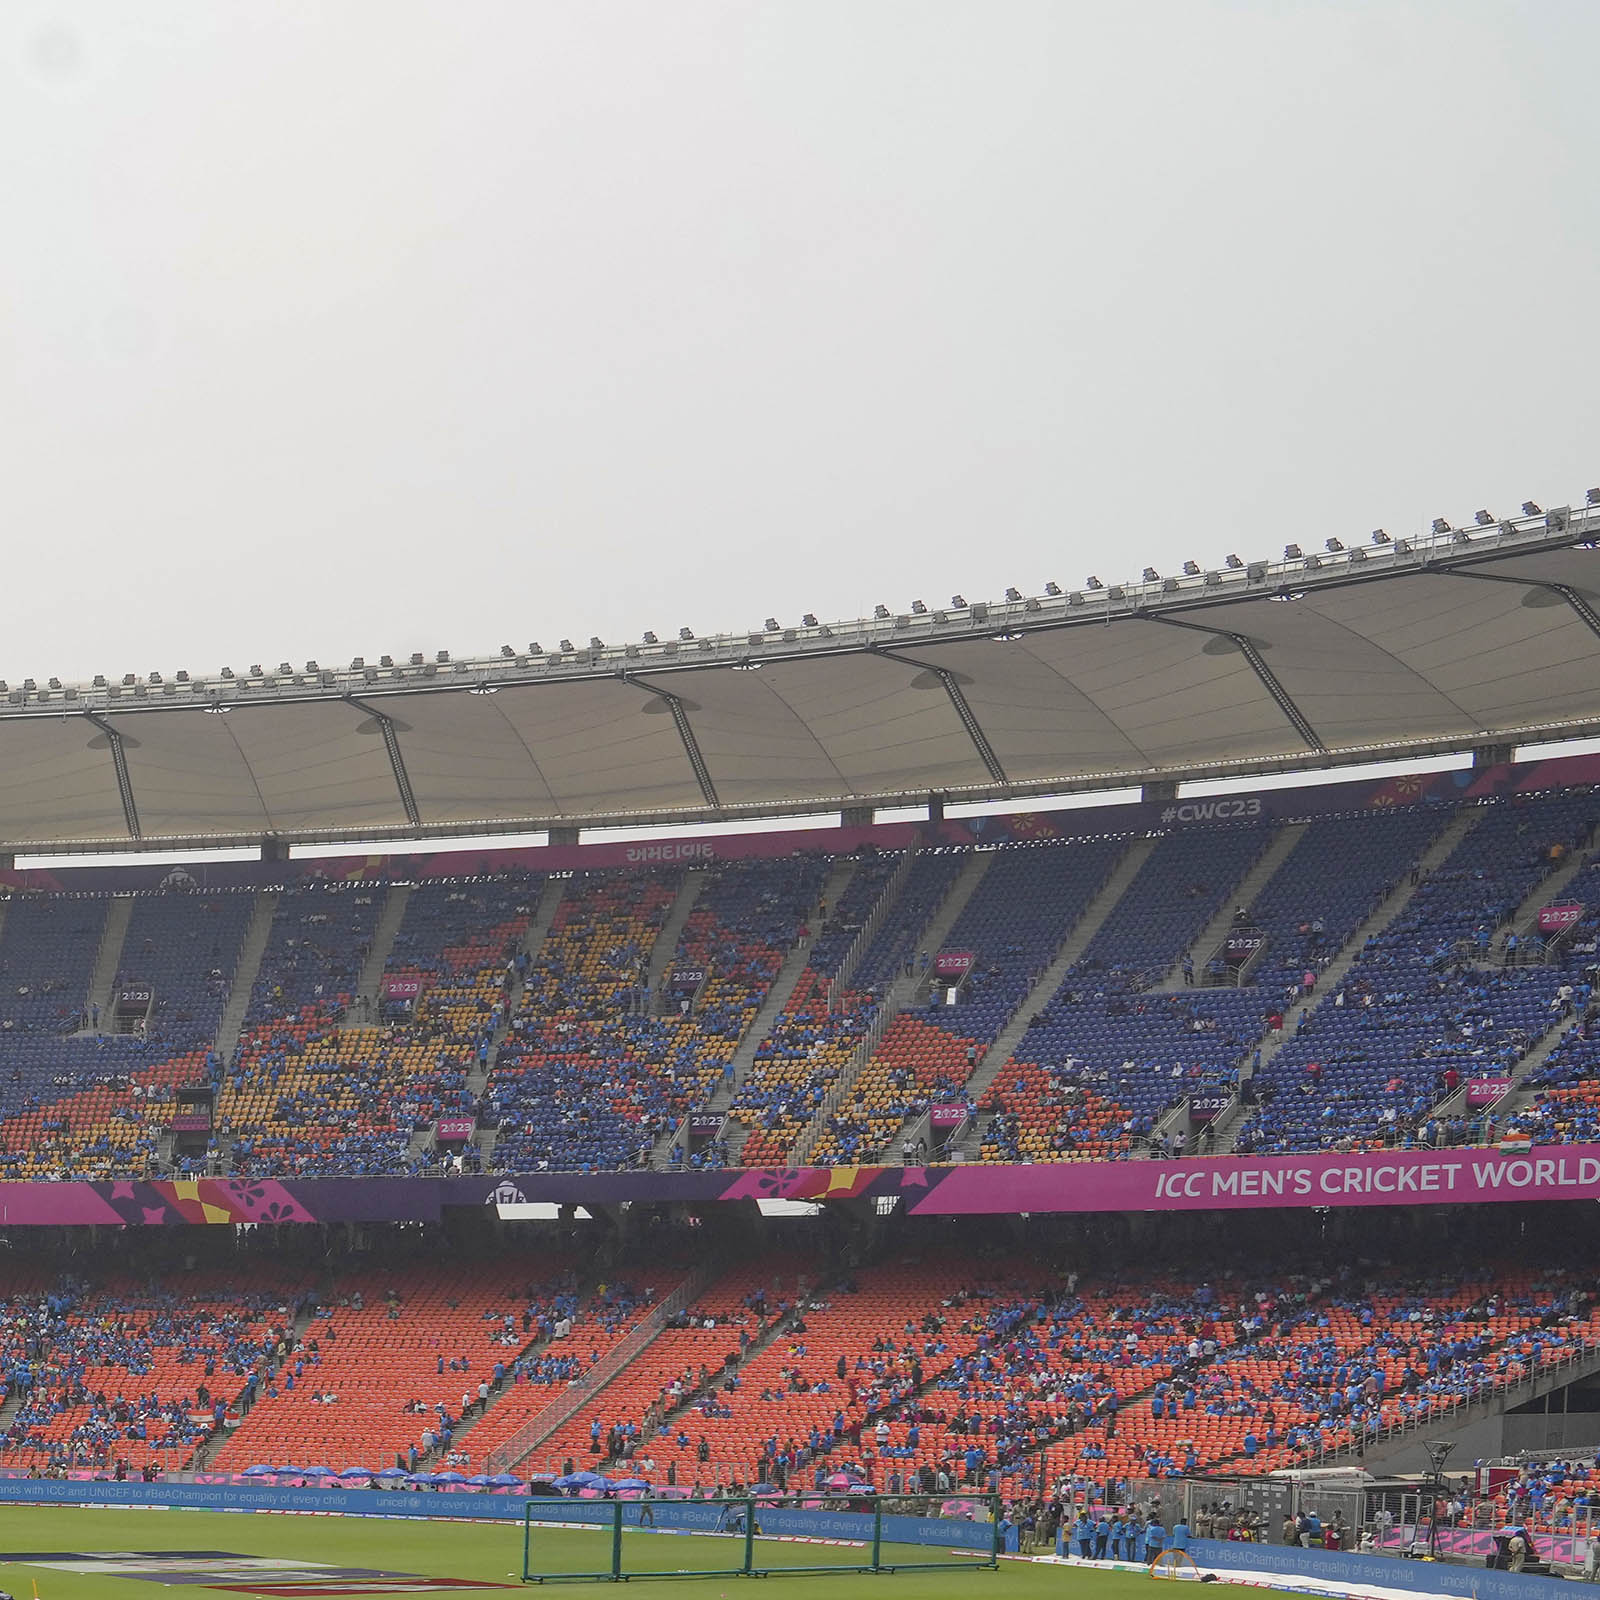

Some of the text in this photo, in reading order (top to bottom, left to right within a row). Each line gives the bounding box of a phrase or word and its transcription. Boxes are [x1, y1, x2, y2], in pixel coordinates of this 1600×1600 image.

[1161, 798, 1261, 823] #CWC23
[1155, 1157, 1600, 1198] ICC MEN'S CRICKET WORLD
